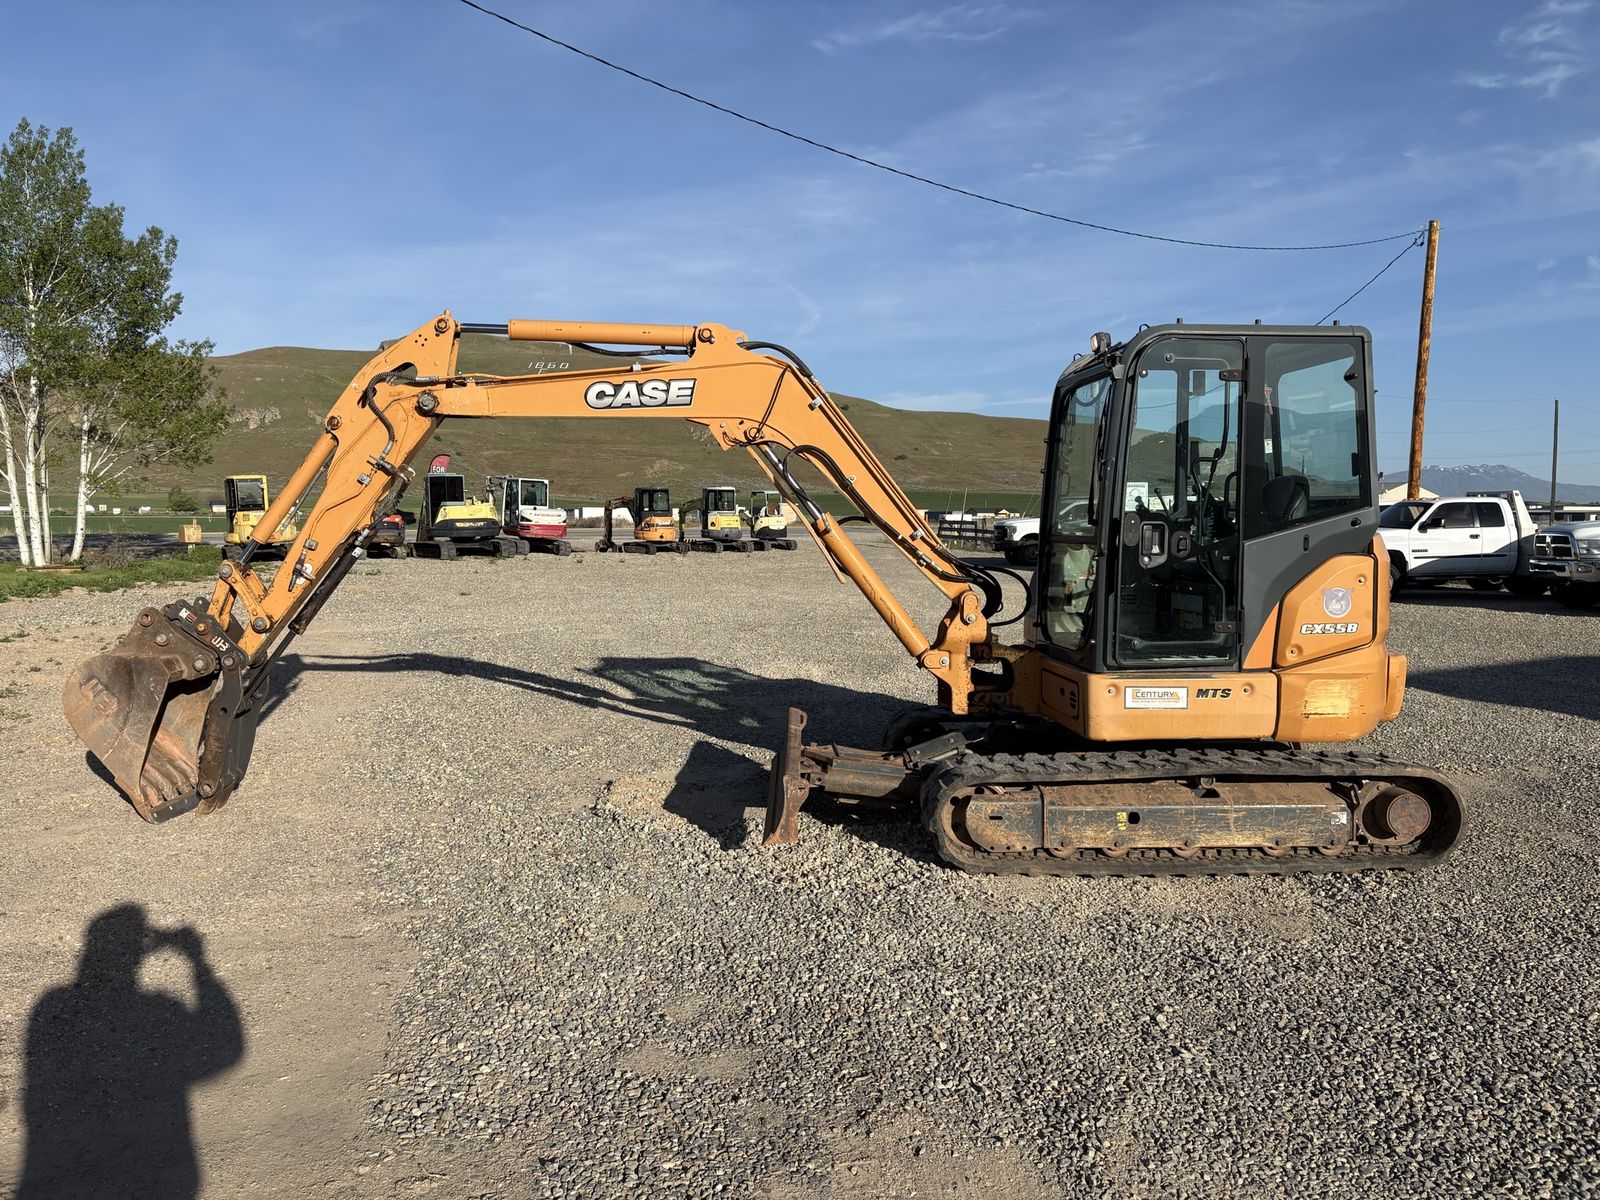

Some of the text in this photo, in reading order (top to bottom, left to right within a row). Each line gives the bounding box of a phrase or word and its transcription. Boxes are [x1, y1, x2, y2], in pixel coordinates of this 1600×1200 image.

[585, 378, 697, 409] CASE
[1300, 623, 1359, 635] CX55B
[1196, 688, 1232, 699] MTS
